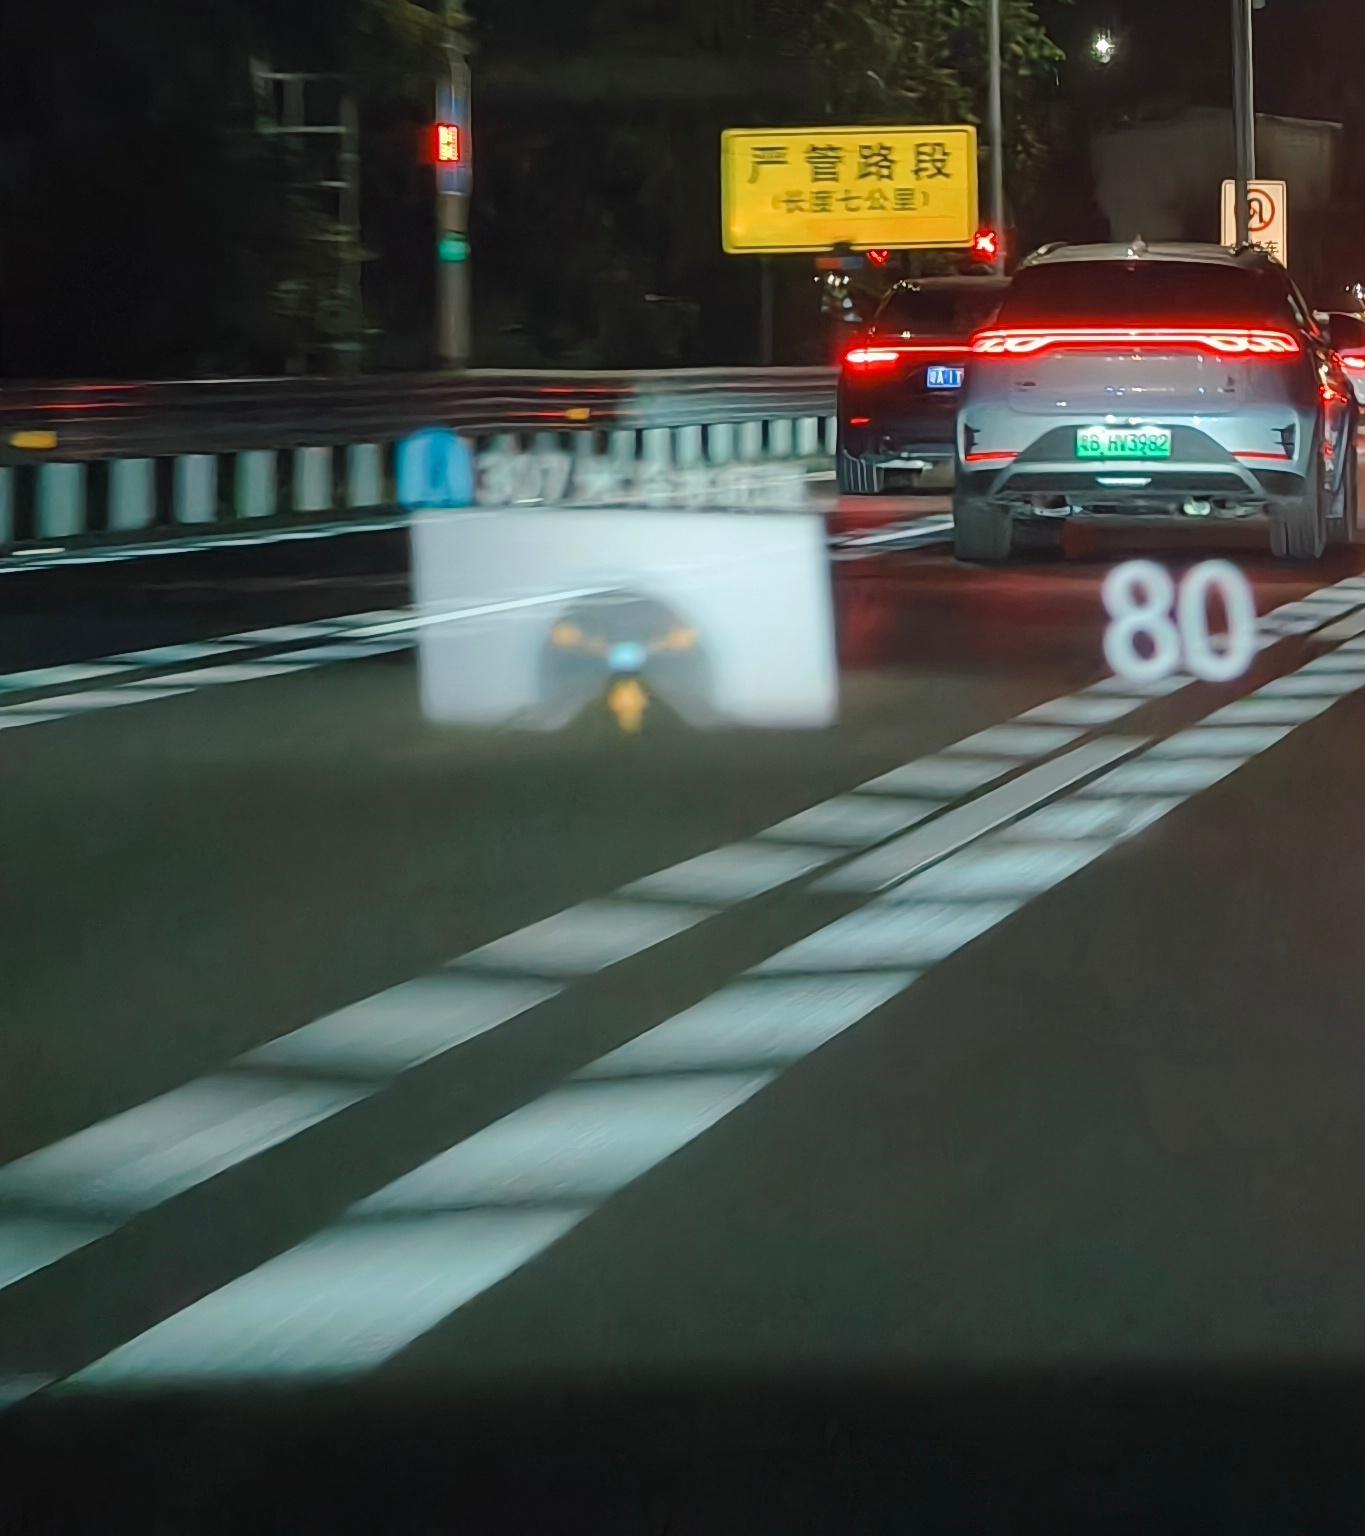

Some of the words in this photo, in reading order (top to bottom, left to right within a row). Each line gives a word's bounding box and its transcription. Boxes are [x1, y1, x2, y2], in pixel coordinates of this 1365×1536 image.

[748, 142, 952, 184] 严管路段
[1102, 558, 1256, 683] 80
